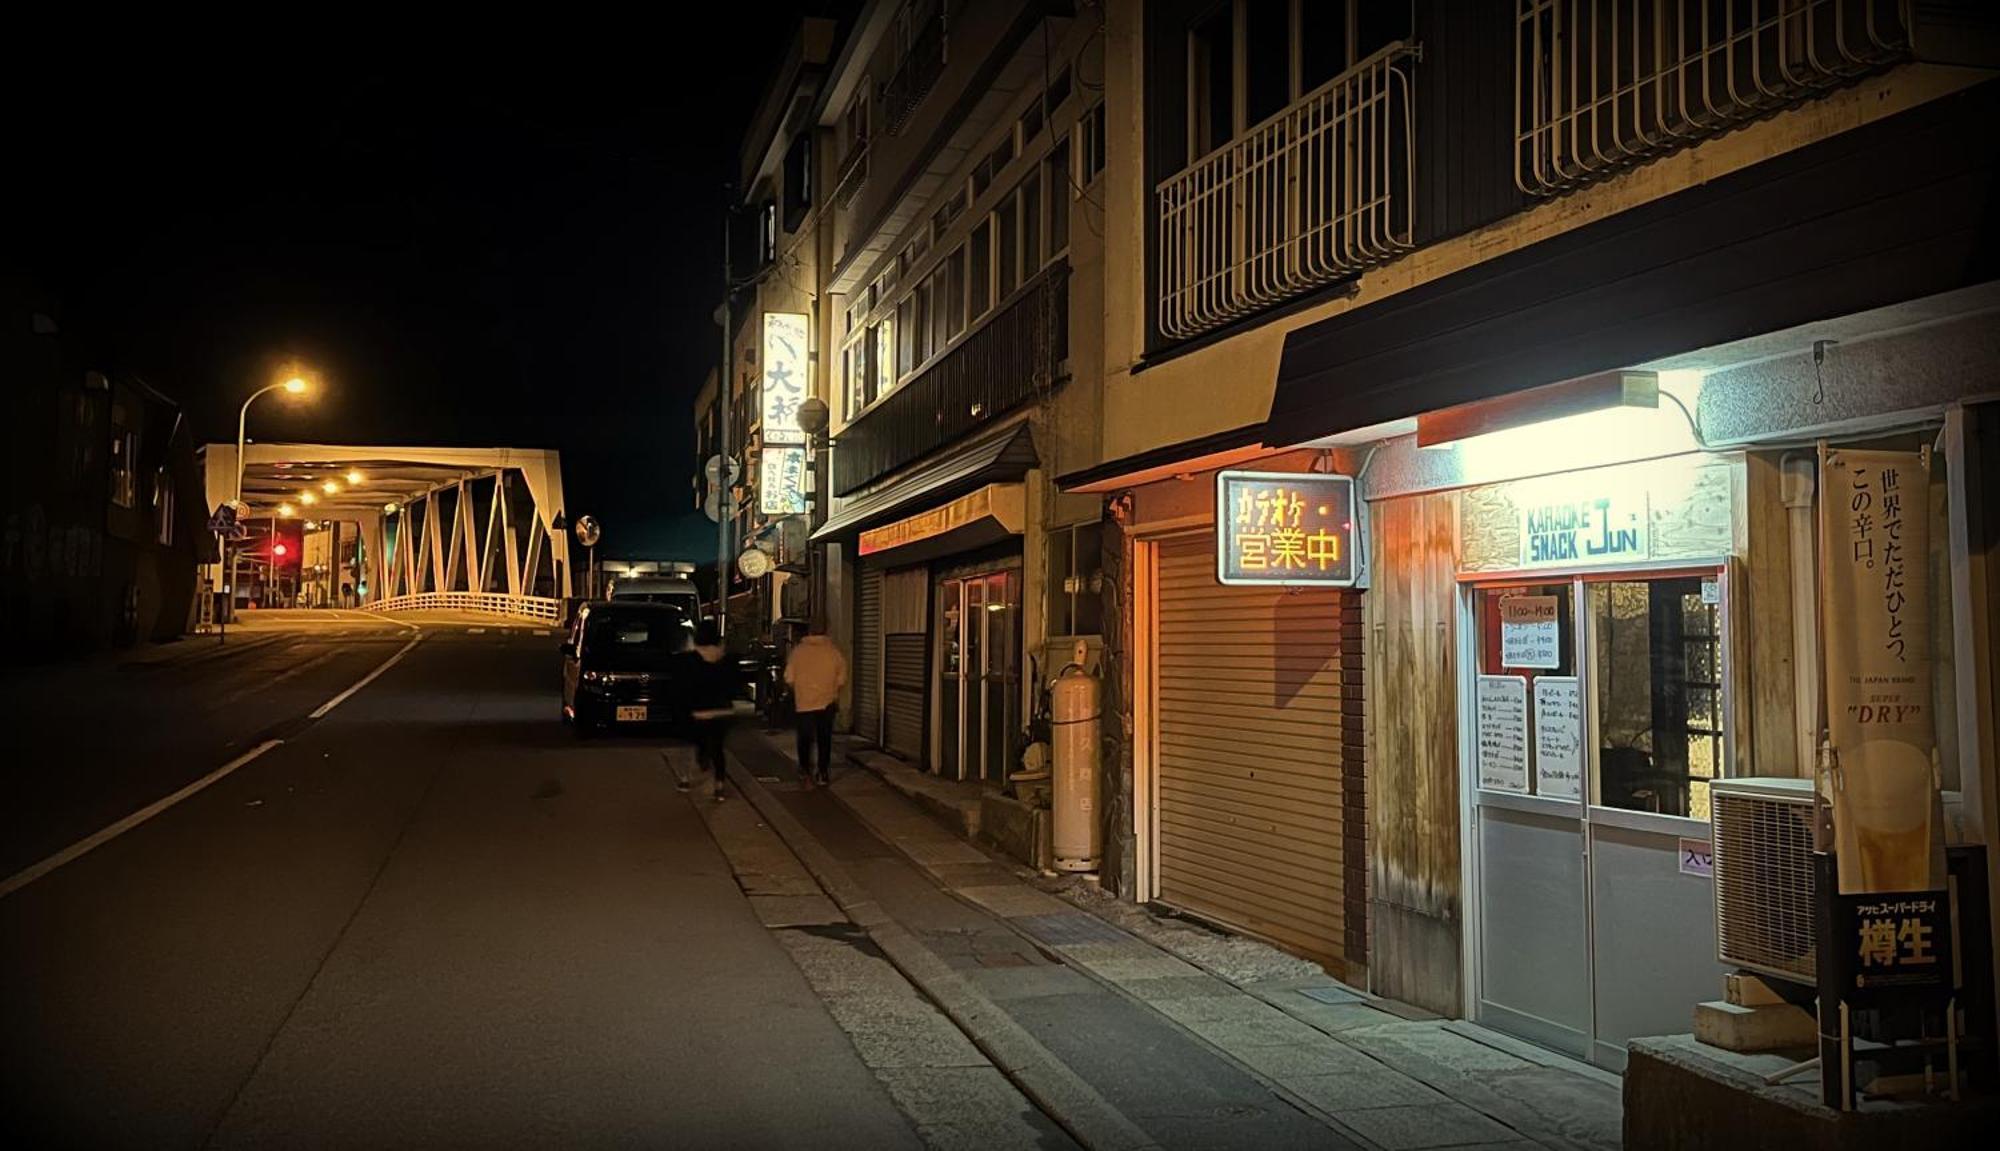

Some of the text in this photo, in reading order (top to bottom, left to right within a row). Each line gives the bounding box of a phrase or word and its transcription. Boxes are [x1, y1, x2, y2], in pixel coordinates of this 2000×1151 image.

[1527, 502, 1591, 535] KARAOKE
[1851, 468, 1875, 570] この辛口。
[1235, 527, 1341, 571] 営業中
[1531, 531, 1578, 561] SNACK
[1881, 468, 1906, 663] 世界でただひとつ、
[1865, 676, 1889, 684] JAPAN
[1870, 695, 1900, 703] SUPER
[1856, 900, 1936, 916] アサヒスーパードライ
[1858, 917, 1937, 967] 樽生
